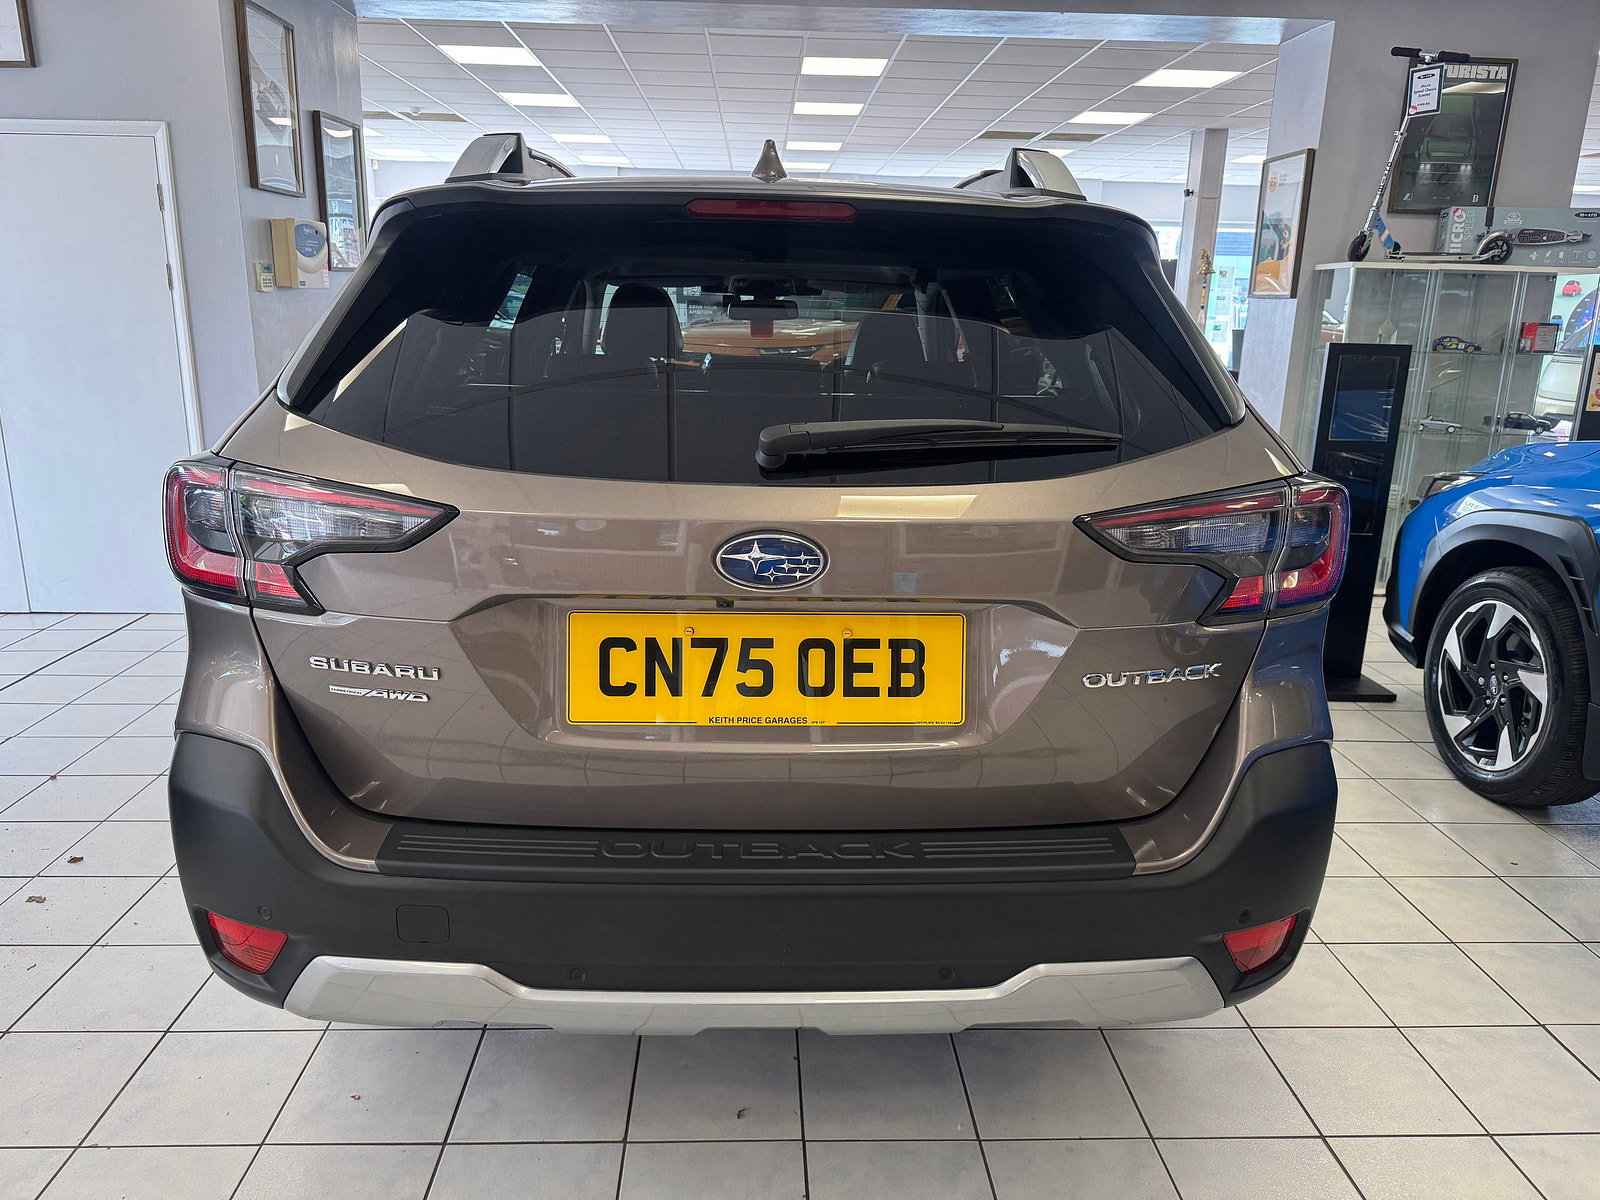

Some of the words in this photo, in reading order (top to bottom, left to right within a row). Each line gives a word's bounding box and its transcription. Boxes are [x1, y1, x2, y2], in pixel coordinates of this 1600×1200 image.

[1444, 64, 1508, 80] URISTA
[1472, 194, 1480, 203] B
[1463, 210, 1476, 240] SPEED
[309, 655, 441, 681] SUBARU
[599, 636, 775, 698] CN75
[797, 637, 926, 698] OEB
[1082, 662, 1223, 689] OUTBACK
[365, 688, 430, 703] AWD
[708, 716, 735, 724] KEITH
[736, 716, 763, 724] PRICE
[764, 716, 808, 724] GARAGES
[602, 841, 916, 860] OUTBACK
